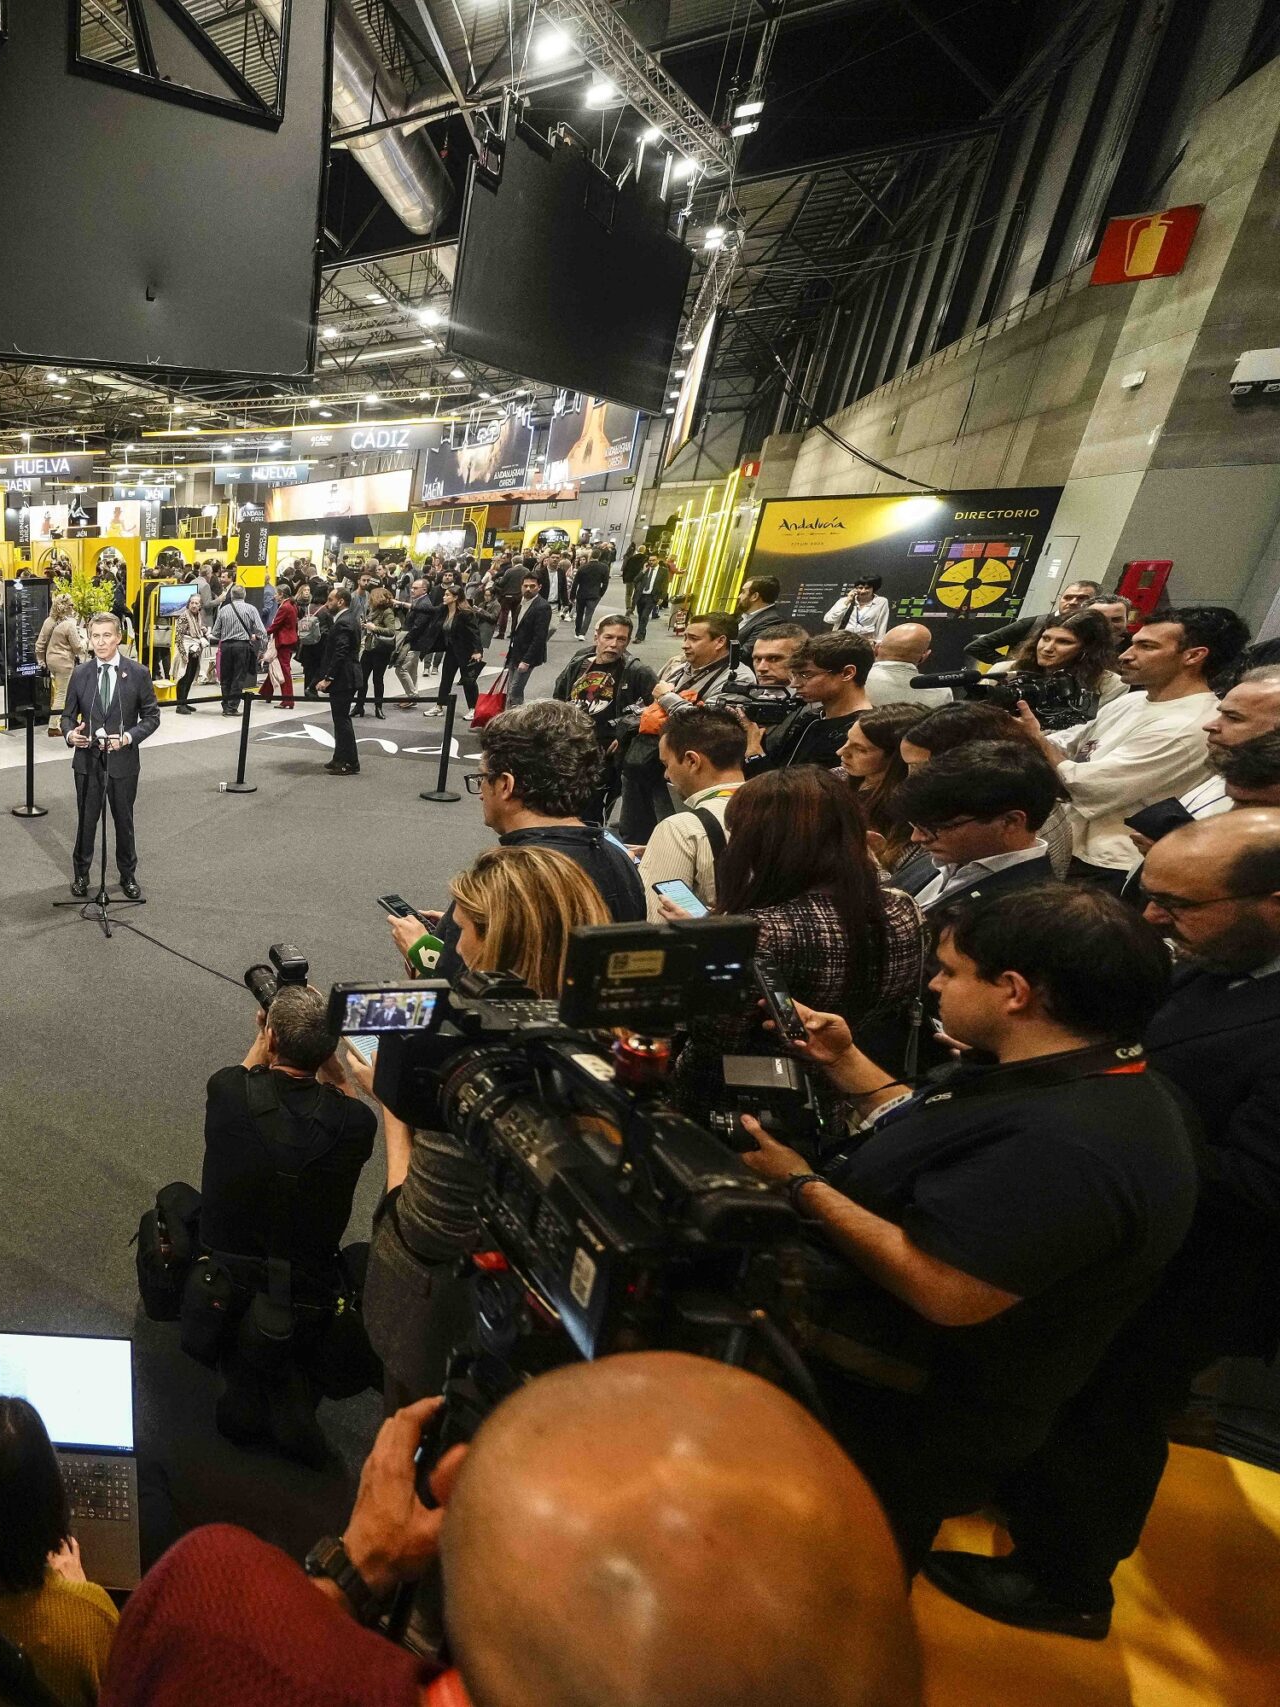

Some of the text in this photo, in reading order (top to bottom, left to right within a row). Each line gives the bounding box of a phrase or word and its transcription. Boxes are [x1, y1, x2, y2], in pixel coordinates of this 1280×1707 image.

[350, 427, 411, 451] CÁDIZ
[13, 457, 71, 475] HUELVA
[251, 465, 297, 481] HUELVA
[423, 478, 445, 499] JAÉN
[778, 516, 847, 531] Andalucía
[954, 508, 1041, 521] DIRECTORIO
[243, 532, 251, 558] CIUDAD
